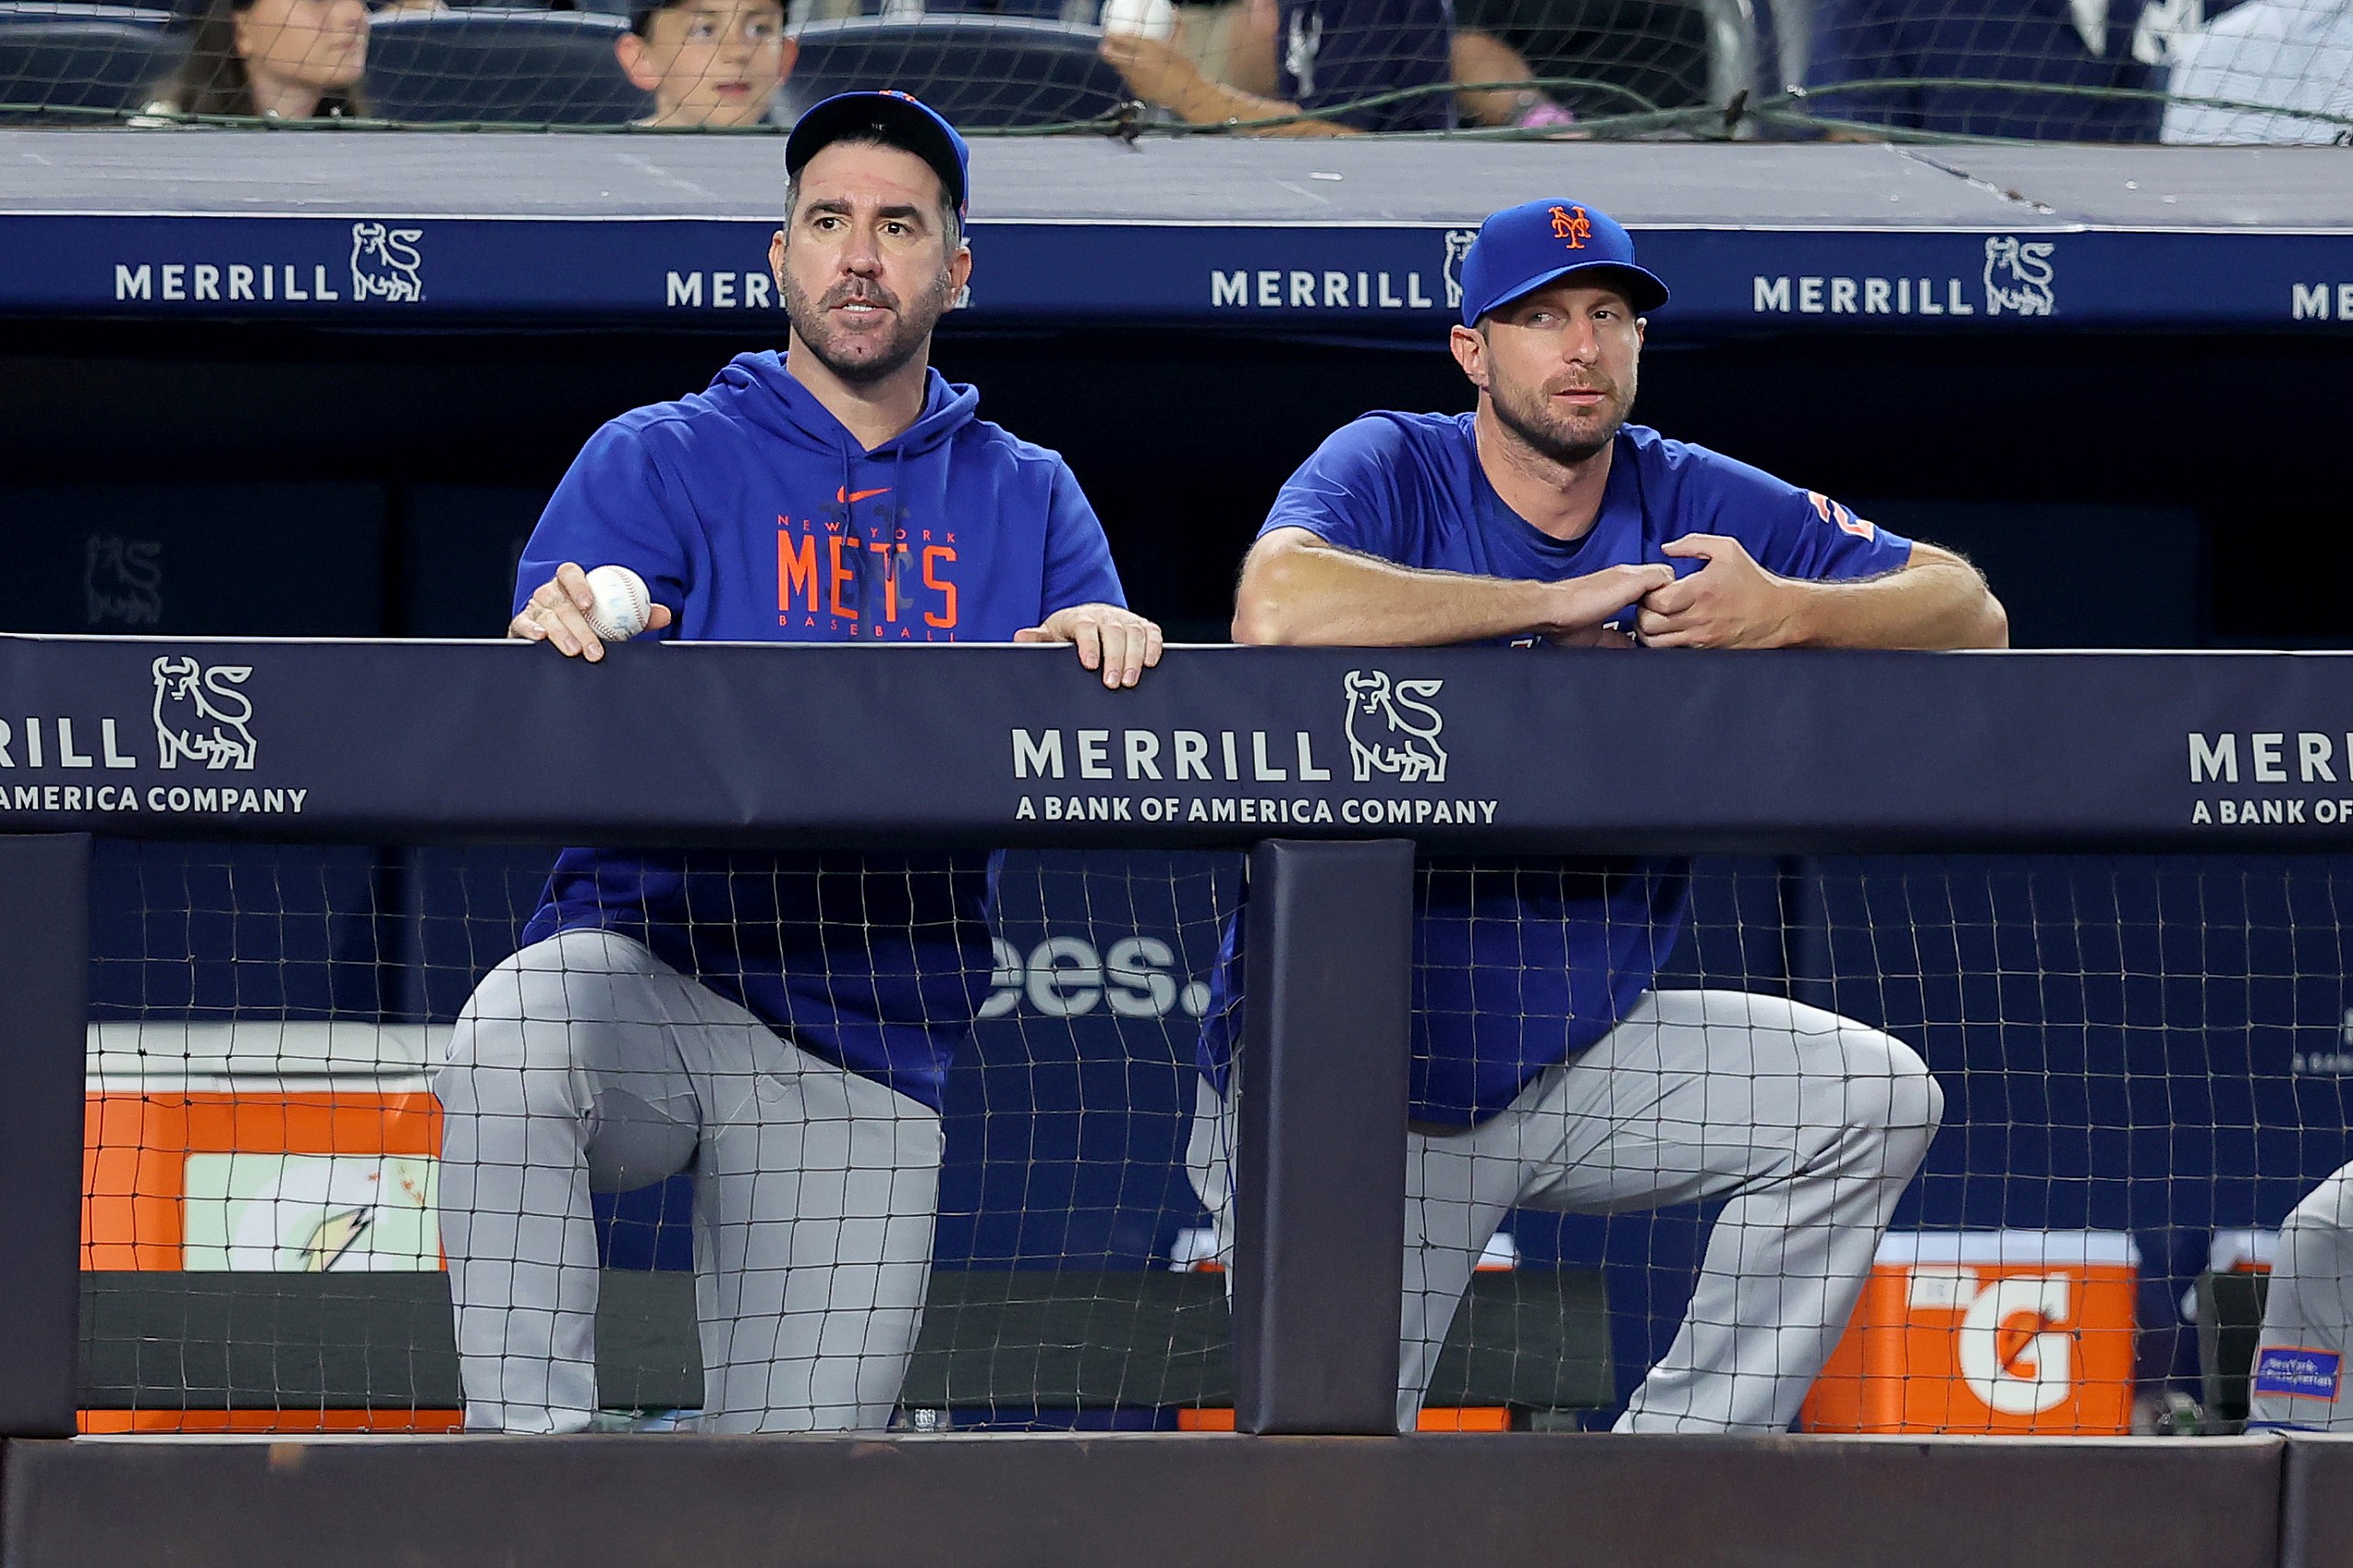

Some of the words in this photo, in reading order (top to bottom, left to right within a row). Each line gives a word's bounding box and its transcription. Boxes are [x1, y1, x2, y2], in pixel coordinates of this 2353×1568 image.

[115, 264, 338, 301] MERRILL
[666, 271, 786, 310] MER
[1211, 270, 1432, 309] MERRILL
[1754, 277, 1973, 315] MERRILL
[778, 514, 840, 532] NEW
[870, 527, 957, 543] YORK
[778, 529, 958, 629] METS
[1011, 729, 1332, 781] MERRILL
[2188, 733, 2353, 782] MER
[147, 787, 308, 812] COMPANY
[1016, 796, 1037, 820] A
[1044, 796, 1131, 821] BANK
[1140, 797, 1179, 822] OF
[1188, 798, 1334, 824] AMERICA
[1341, 799, 1498, 824] COMPANY
[2191, 800, 2212, 824] A
[2219, 800, 2306, 824] BANK
[2314, 799, 2353, 824] OF
[1959, 1271, 2071, 1416] G
